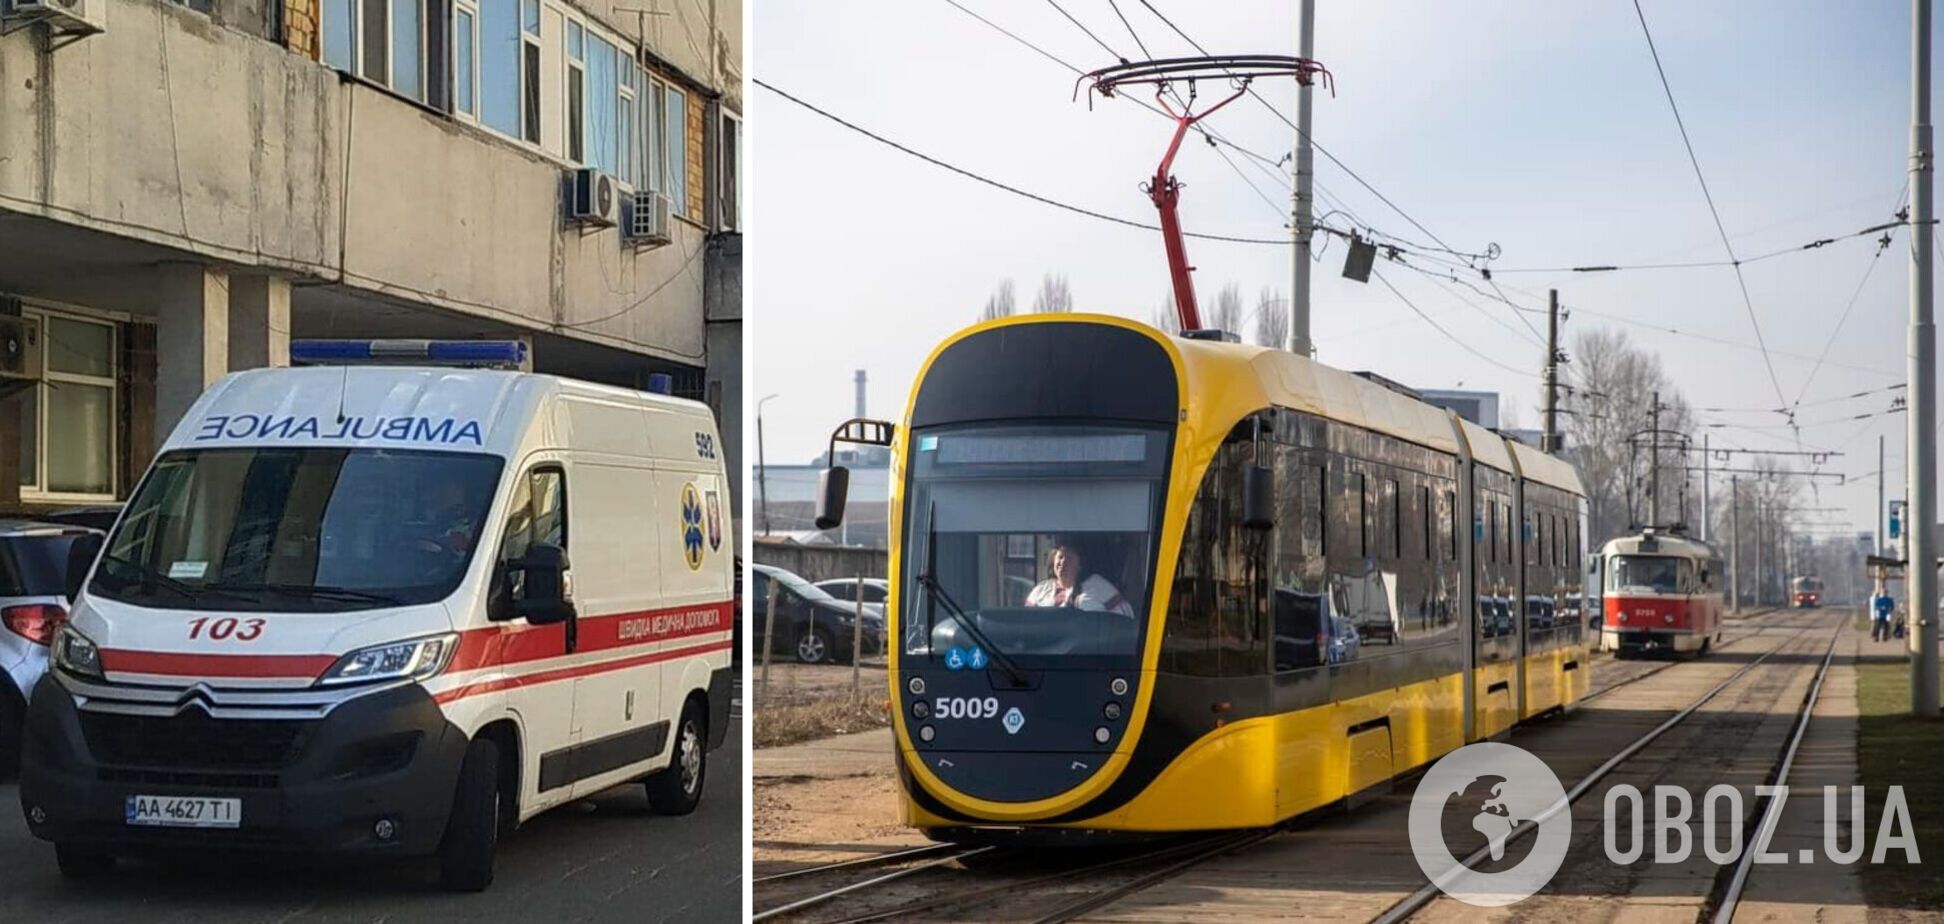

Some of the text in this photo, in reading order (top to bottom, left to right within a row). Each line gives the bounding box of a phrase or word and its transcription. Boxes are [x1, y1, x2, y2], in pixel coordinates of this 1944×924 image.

[694, 431, 715, 459] 592
[188, 617, 267, 641] 103
[618, 609, 720, 640] ШВИДКА МЕДИЧНА ДОПОМОГА
[934, 697, 999, 719] 5009
[137, 798, 161, 817] AA
[165, 800, 205, 819] 4627
